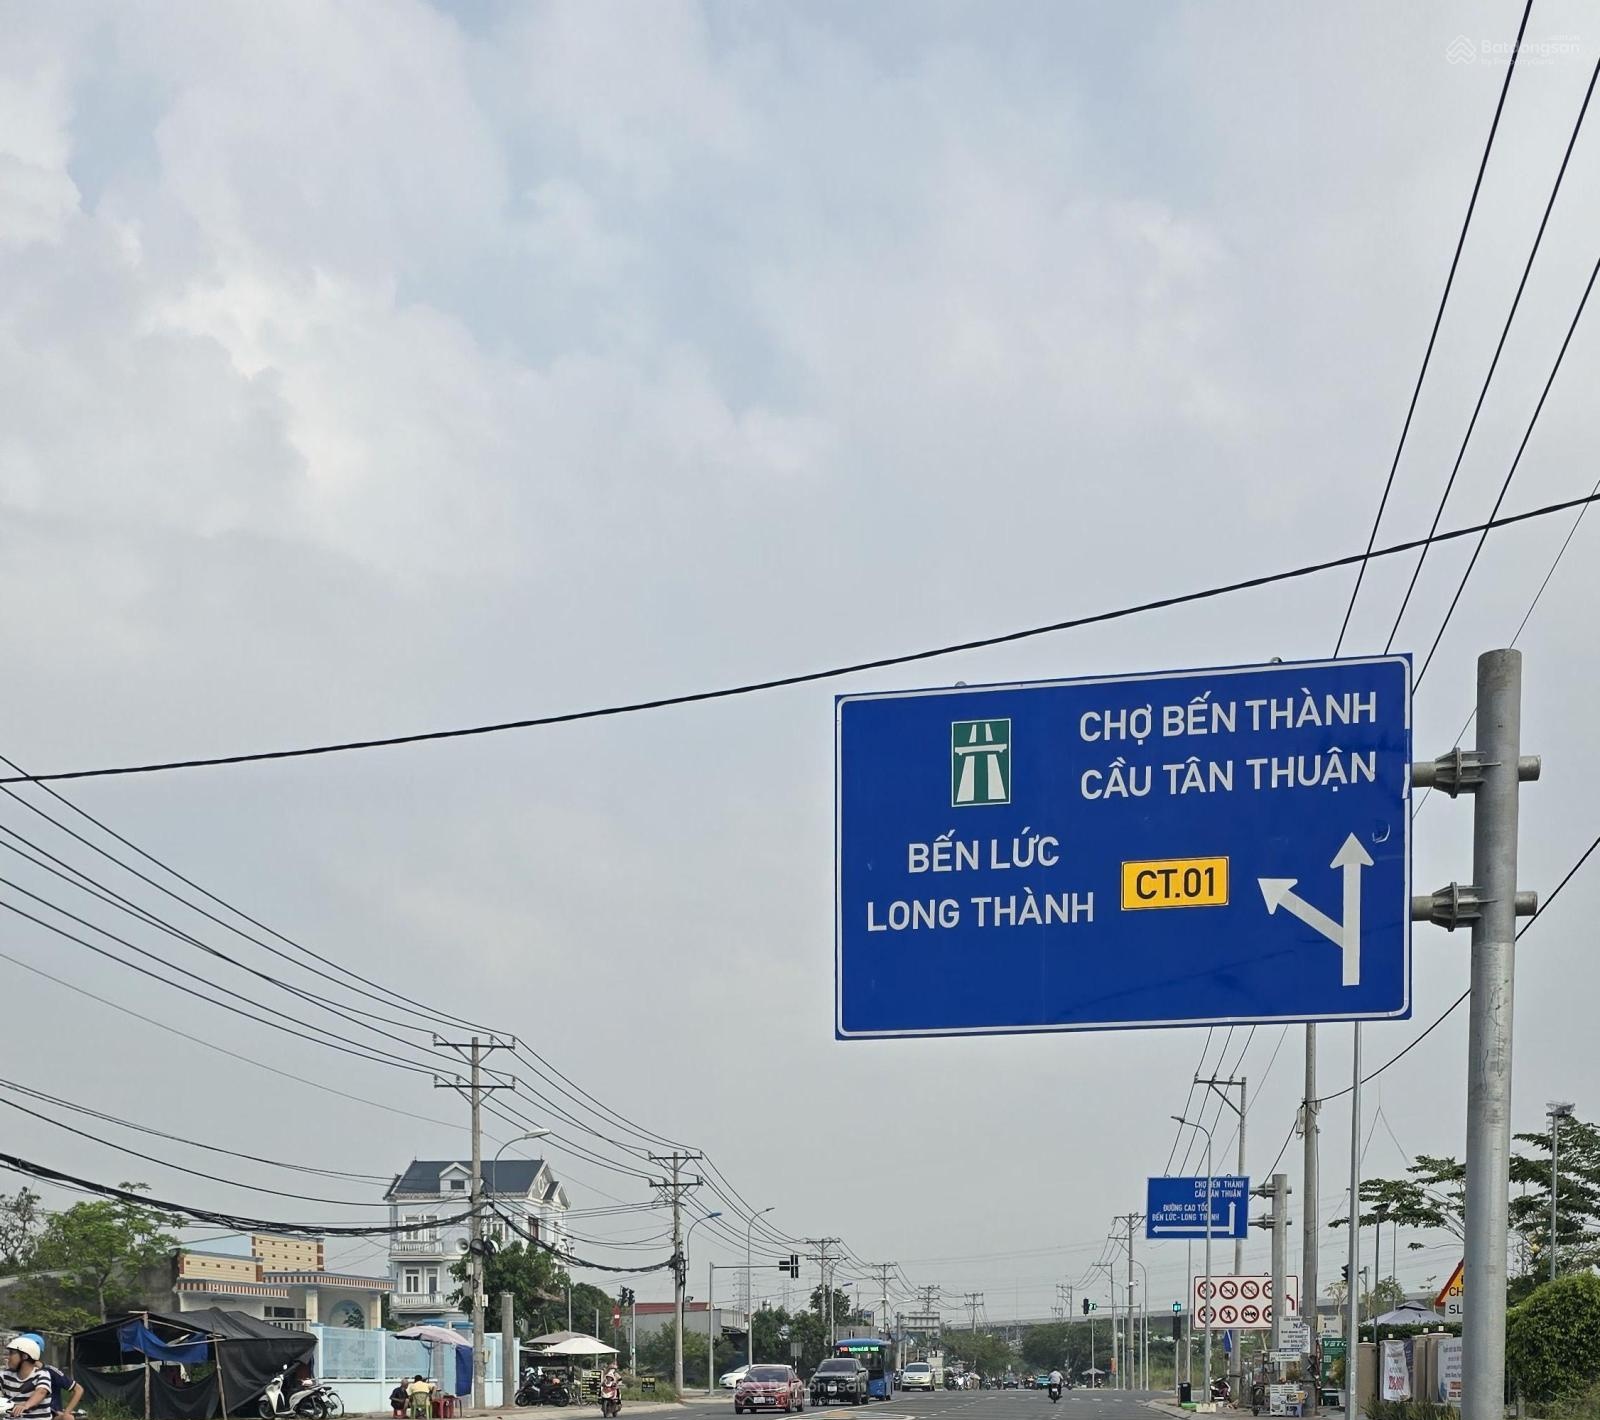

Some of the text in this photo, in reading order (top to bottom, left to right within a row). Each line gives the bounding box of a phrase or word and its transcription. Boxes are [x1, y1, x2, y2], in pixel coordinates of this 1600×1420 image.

[1080, 687, 1377, 745] CHỢ BẾN THÀNH
[1080, 746, 1376, 800] CẦU TÂN THUẬN
[908, 826, 1060, 874] BẾN LỨC
[1136, 867, 1215, 900] CT.01
[867, 886, 1094, 932] LONG THÀNH
[1208, 1178, 1221, 1189] ẾN
[1184, 1204, 1196, 1212] CAO
[1199, 1212, 1220, 1222] THNH
[1449, 1286, 1464, 1297] CH
[1449, 1304, 1464, 1315] SL
